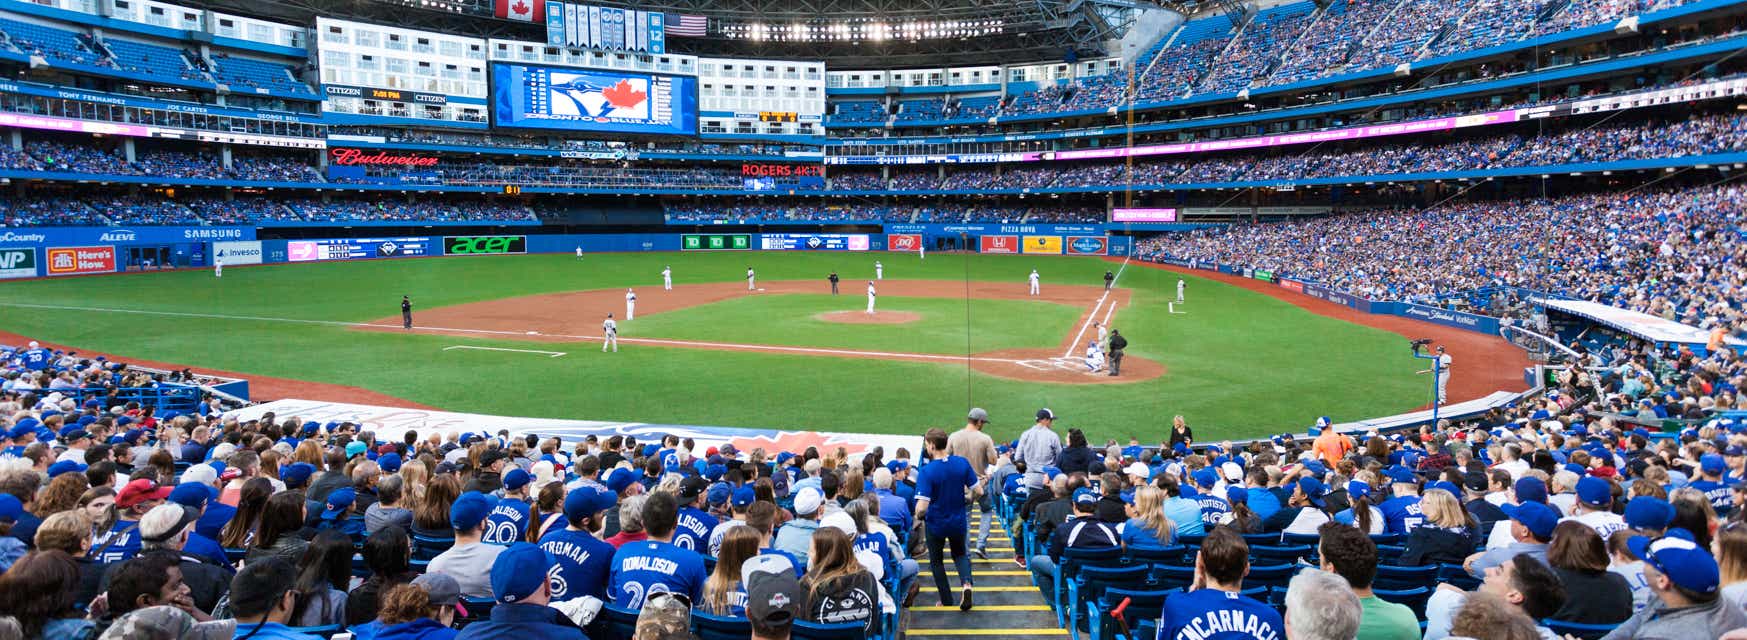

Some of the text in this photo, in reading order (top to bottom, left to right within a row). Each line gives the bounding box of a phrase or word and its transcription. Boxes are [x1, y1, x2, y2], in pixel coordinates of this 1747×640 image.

[650, 30, 662, 41] 12
[59, 91, 80, 99] TONY
[326, 86, 360, 96] CITIZEN
[415, 94, 446, 103] CITIZEN
[333, 149, 438, 166] Budweiser
[742, 165, 791, 176] ROGERS
[184, 229, 241, 238] SAMSUNG
[451, 236, 520, 254] acer
[687, 238, 699, 247] TD
[78, 250, 111, 259] Here's
[1199, 499, 1227, 512] AUTISTA
[481, 519, 518, 544] 20
[540, 540, 590, 565] TROMAN
[623, 556, 679, 576] DONALDSON
[547, 563, 567, 597] 6
